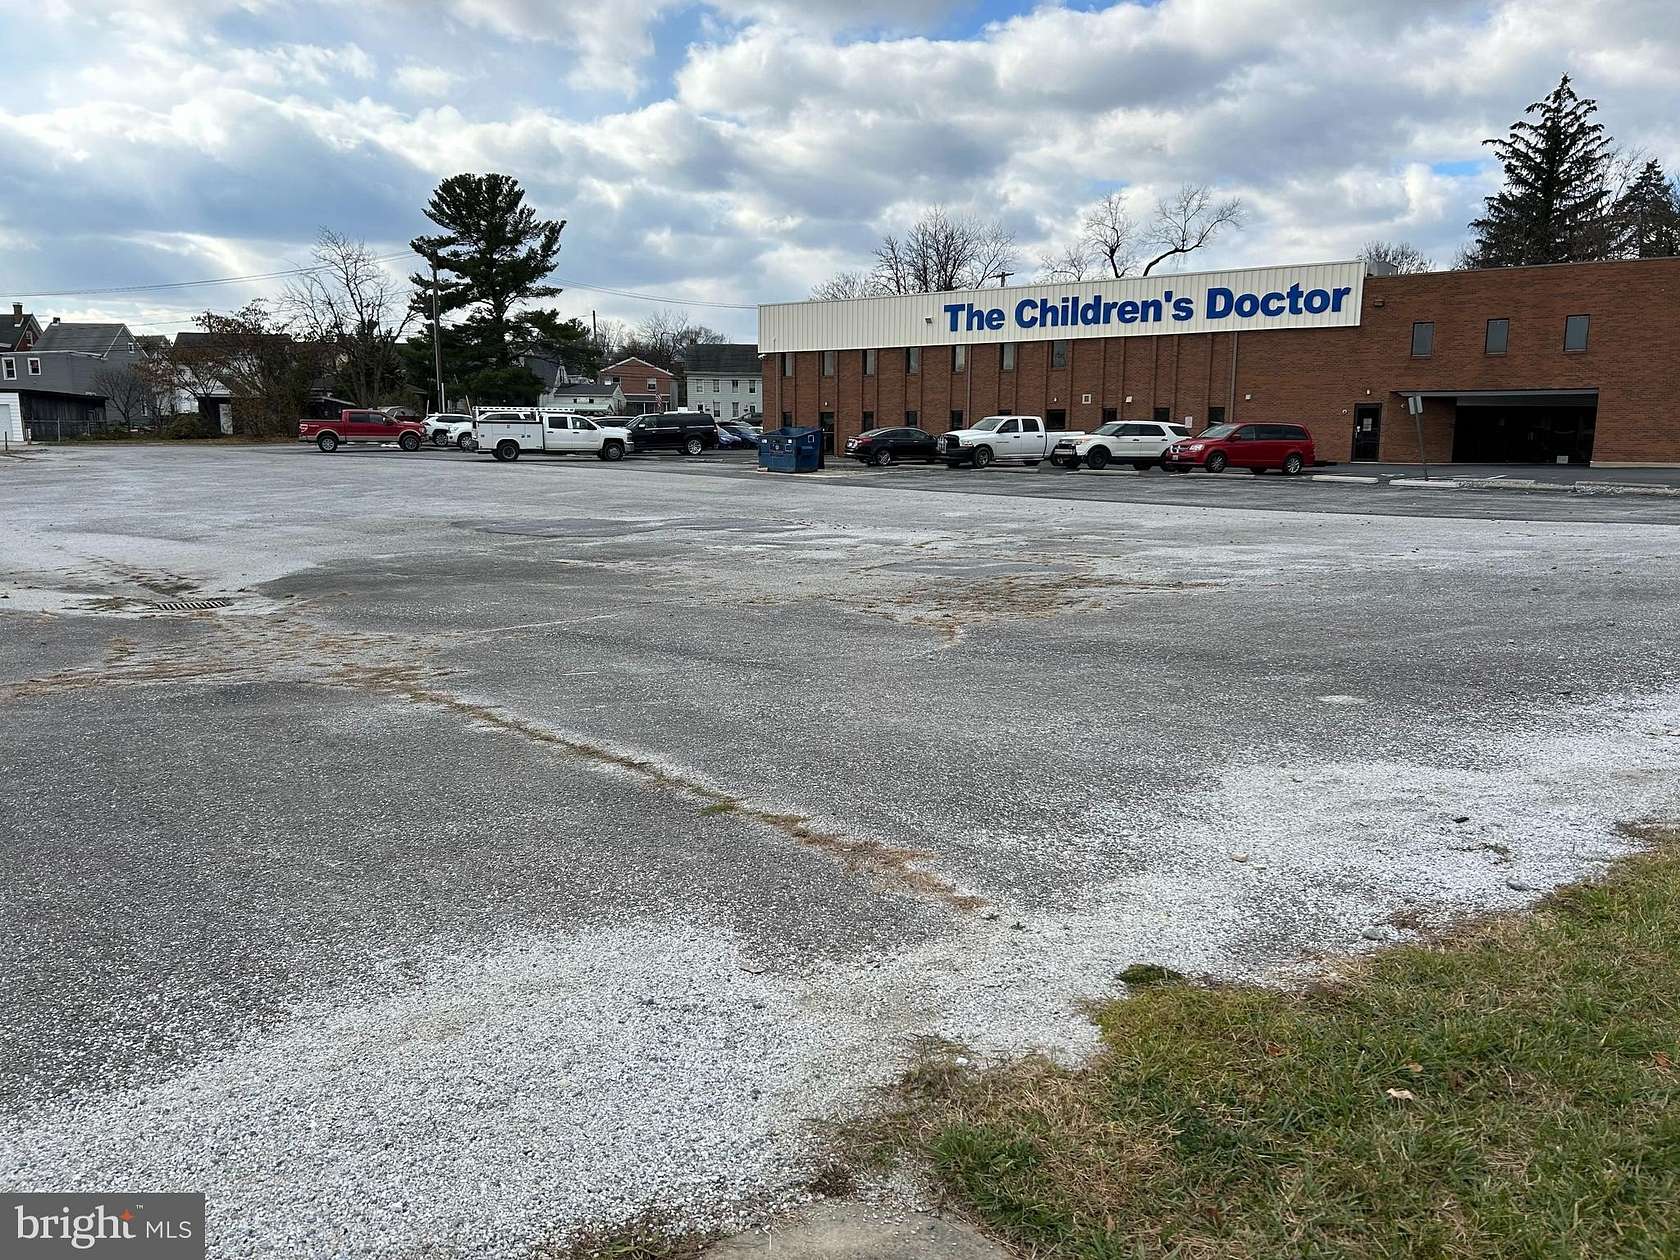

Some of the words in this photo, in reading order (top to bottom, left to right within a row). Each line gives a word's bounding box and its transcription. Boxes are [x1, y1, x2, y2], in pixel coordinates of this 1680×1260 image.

[943, 302, 1005, 332] The
[1014, 290, 1194, 328] Children's
[1206, 282, 1352, 319] Doctor
